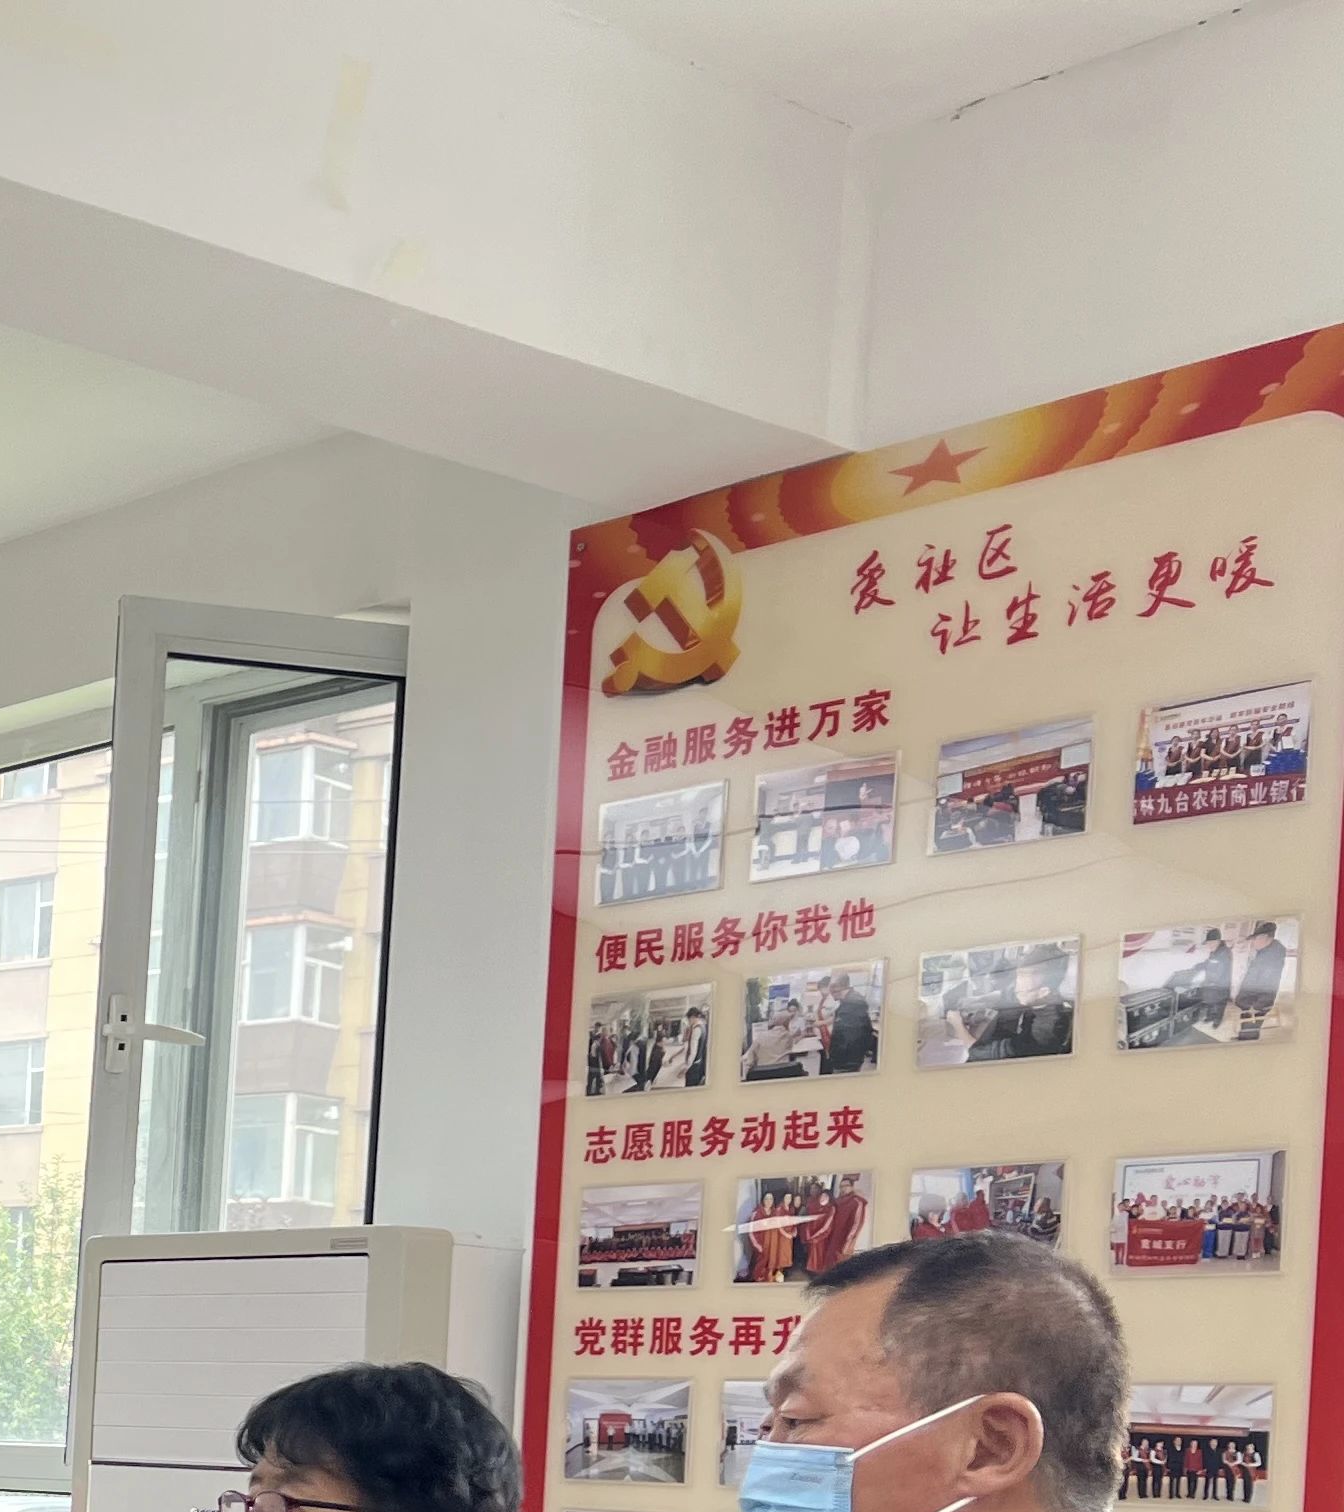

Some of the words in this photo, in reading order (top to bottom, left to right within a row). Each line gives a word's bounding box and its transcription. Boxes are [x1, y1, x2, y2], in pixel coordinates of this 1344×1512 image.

[606, 687, 894, 782] 金融服务进万家
[595, 896, 878, 976] 便民服务你我他
[583, 1105, 866, 1165] 志愿服务动起来
